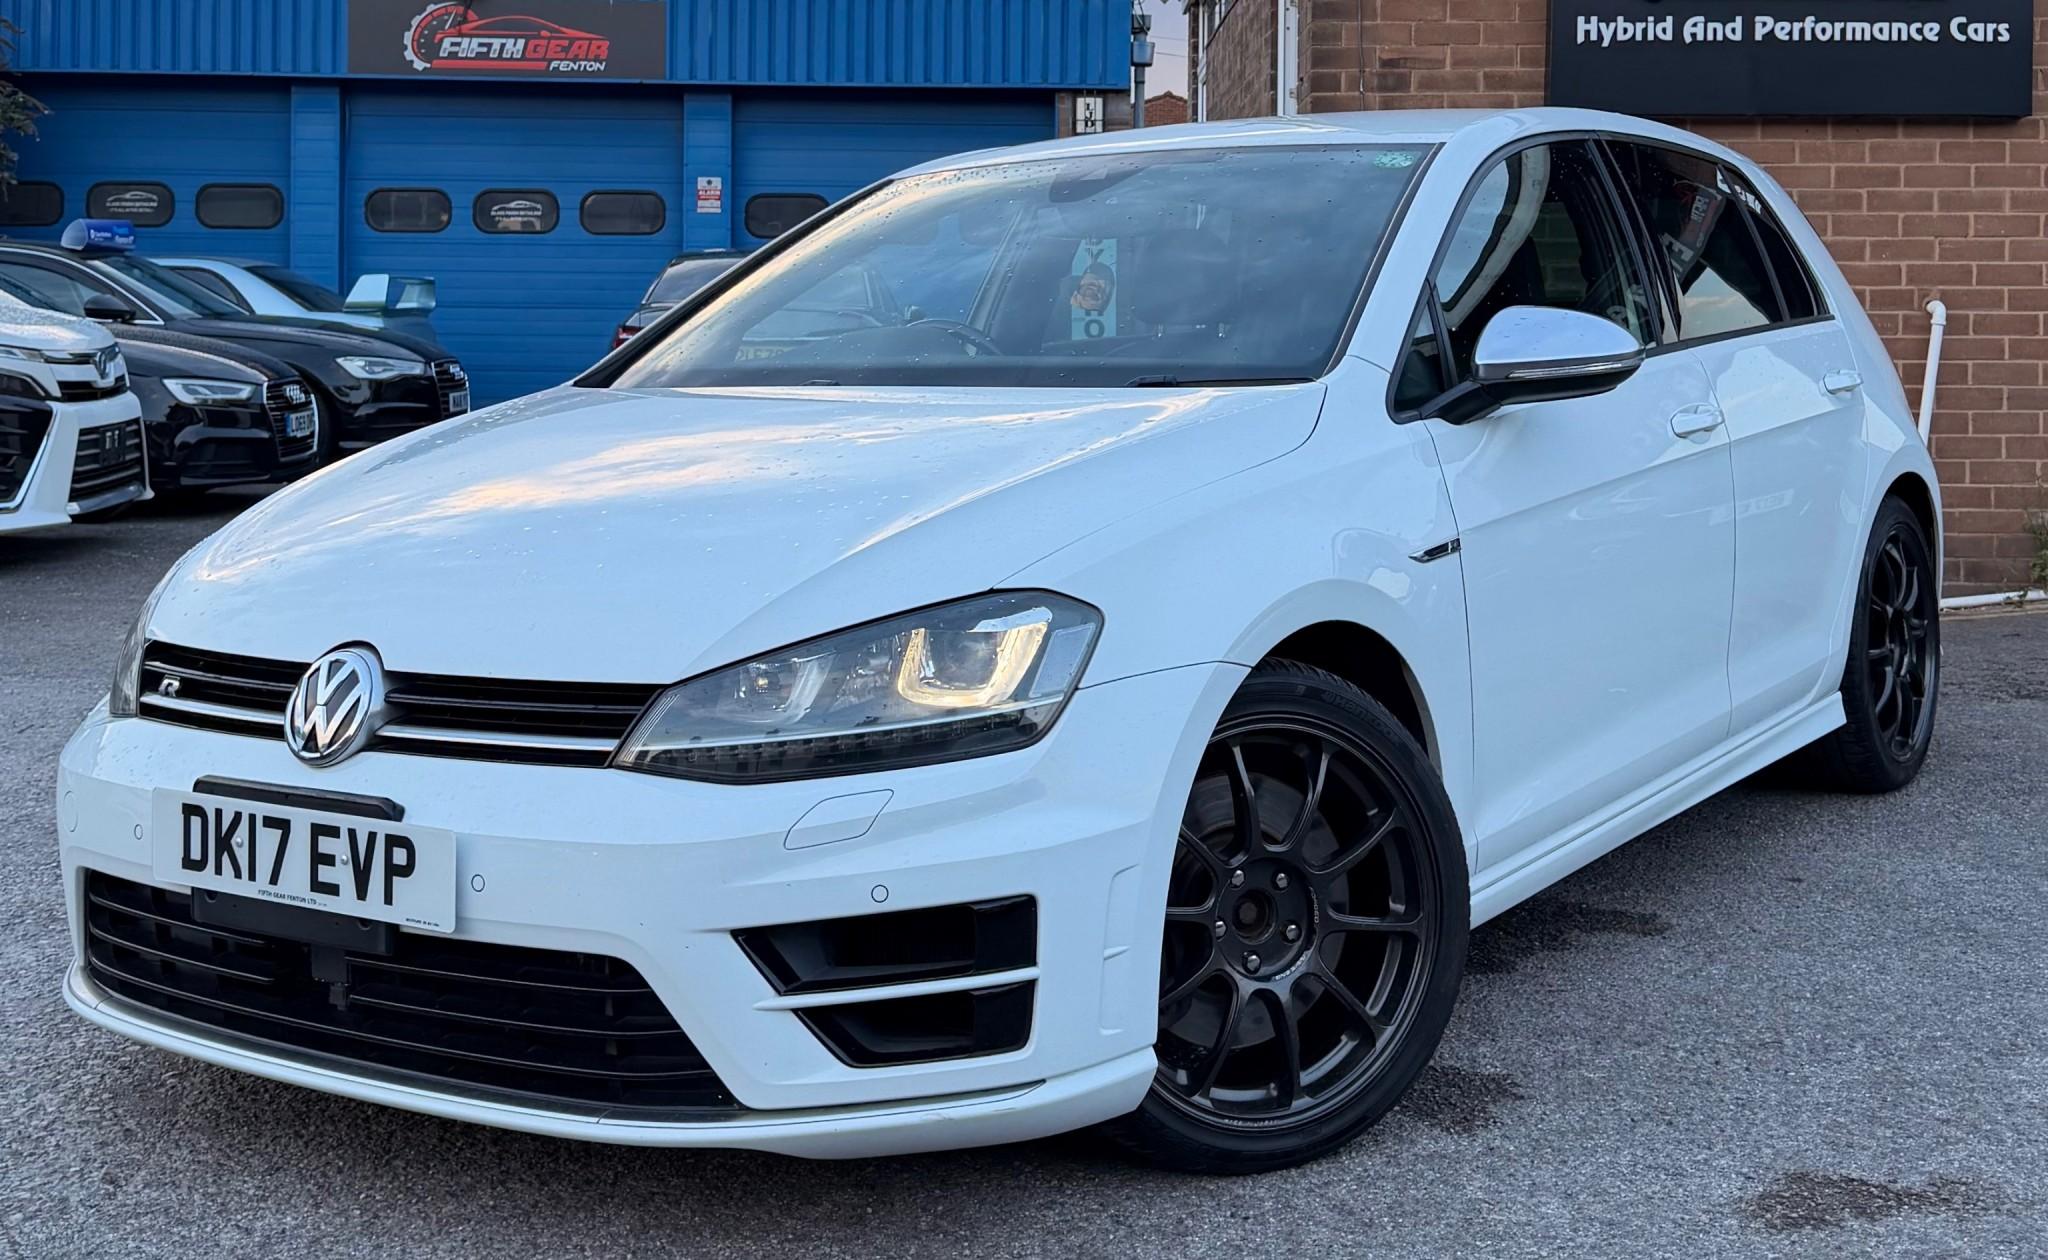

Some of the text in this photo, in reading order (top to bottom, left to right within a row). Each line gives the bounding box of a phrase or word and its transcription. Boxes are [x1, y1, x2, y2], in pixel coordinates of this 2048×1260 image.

[1576, 16, 2011, 47] Hybrid And Performance Cars
[439, 37, 609, 59] FIFTH GEAR
[549, 61, 606, 72] FENTON
[159, 675, 181, 697] R
[181, 802, 416, 906] DK17 EVP
